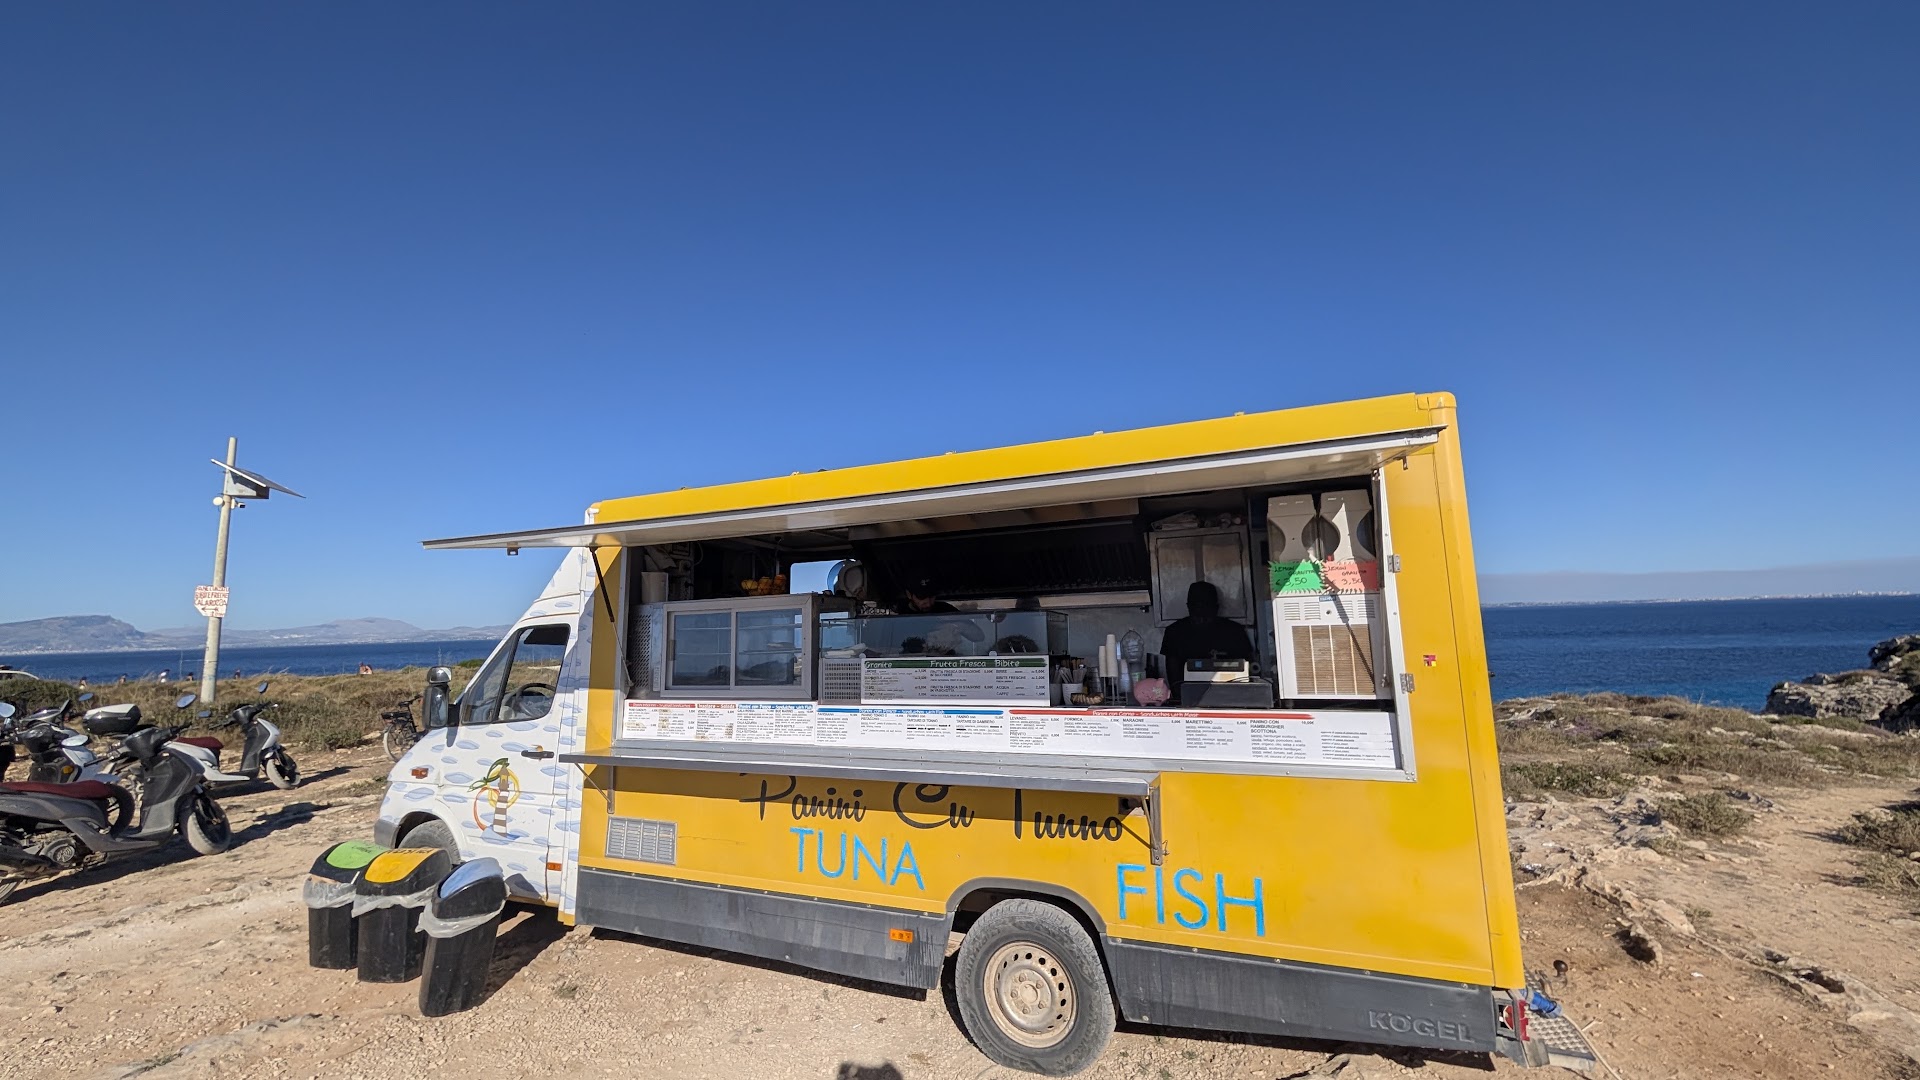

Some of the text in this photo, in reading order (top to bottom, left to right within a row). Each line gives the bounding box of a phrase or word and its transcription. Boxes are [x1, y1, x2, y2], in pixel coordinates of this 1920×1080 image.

[929, 659, 987, 668] Frutta Fresca
[995, 658, 1020, 668] Bibite
[737, 772, 867, 823] Panini
[789, 827, 926, 891] TUNA
[1115, 862, 1266, 938] FISH
[1368, 1010, 1476, 1044] KÖGEL
